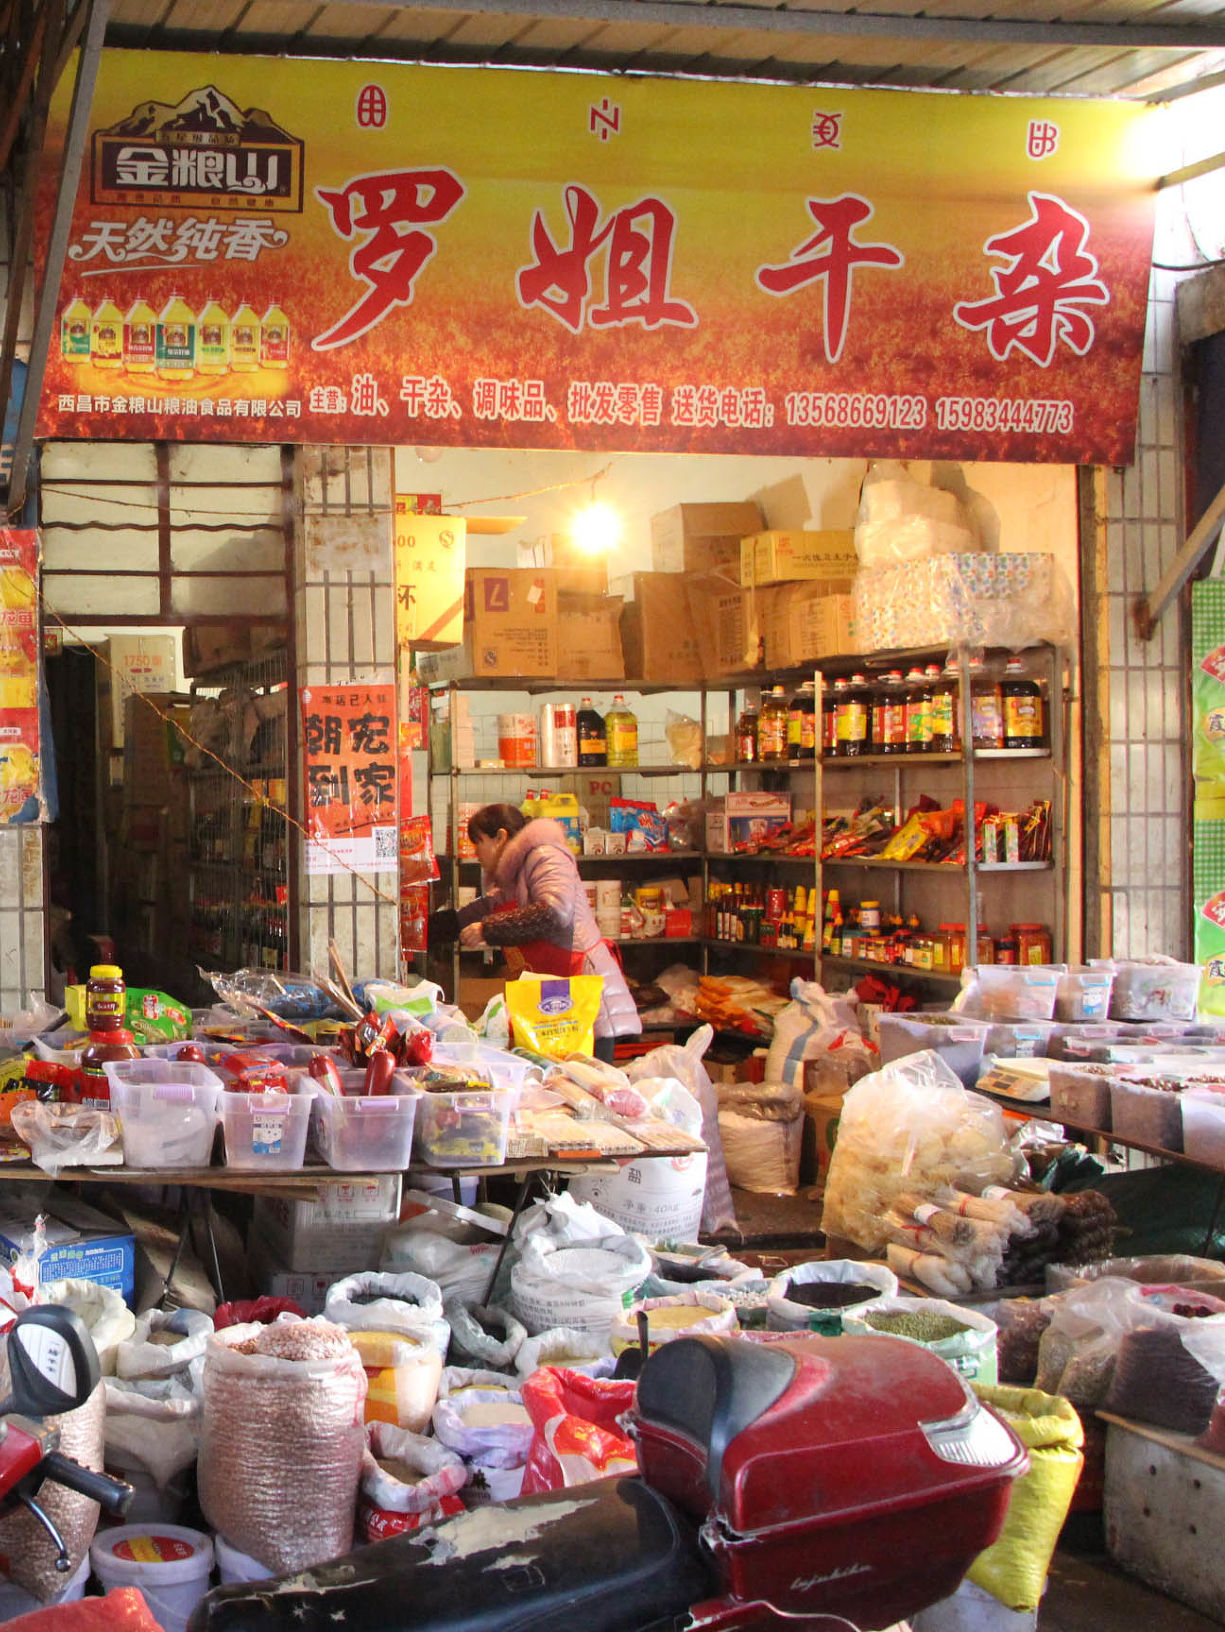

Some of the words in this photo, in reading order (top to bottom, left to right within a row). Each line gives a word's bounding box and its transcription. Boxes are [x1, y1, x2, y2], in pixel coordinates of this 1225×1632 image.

[116, 147, 278, 194] 金粮山
[69, 217, 289, 262] 天然纯香
[311, 166, 1110, 367] 罗姐干杂
[57, 394, 302, 418] 西昌市金粮山粮油食品有限公司
[935, 399, 1074, 434] 15983444773
